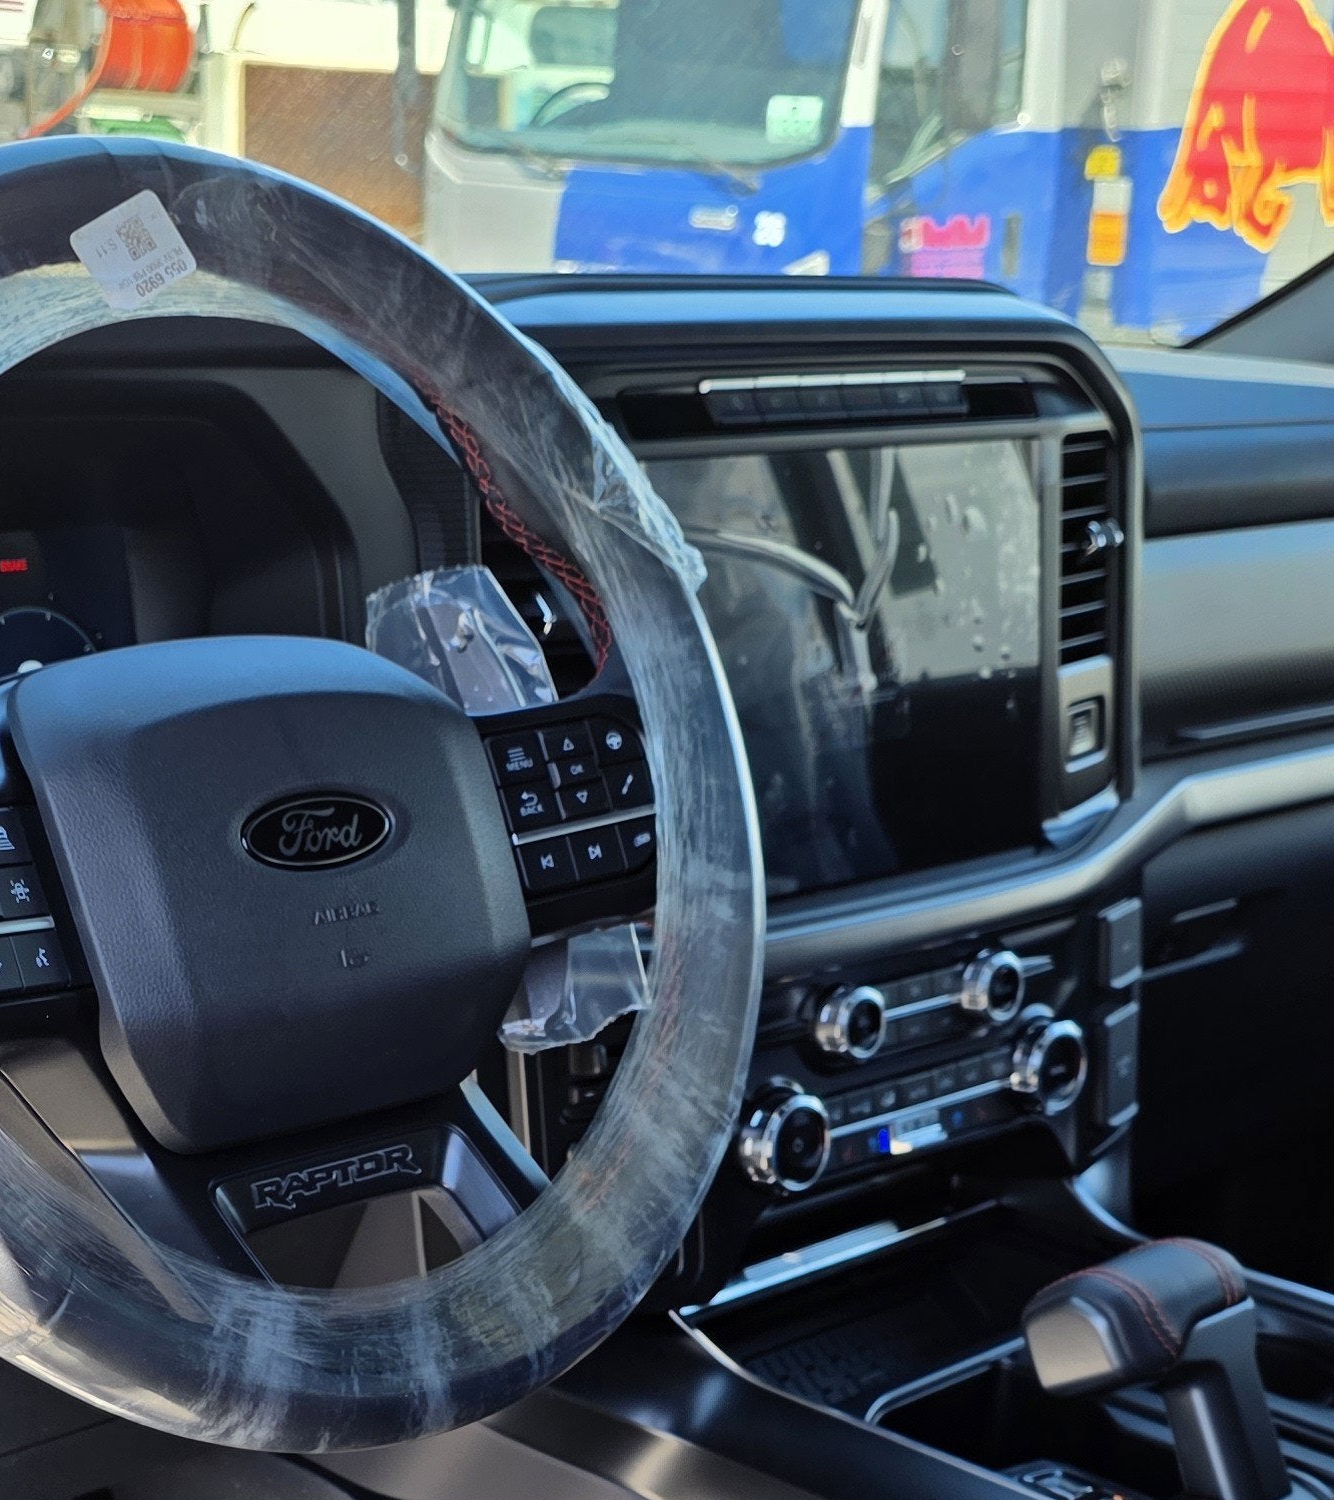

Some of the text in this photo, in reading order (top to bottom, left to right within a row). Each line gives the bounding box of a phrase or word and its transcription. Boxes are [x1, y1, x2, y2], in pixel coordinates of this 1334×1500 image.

[165, 259, 188, 278] 055
[135, 272, 165, 297] 6920
[520, 803, 545, 817] BACK
[277, 806, 362, 857] Ford
[250, 1143, 422, 1210] RAPTOR
